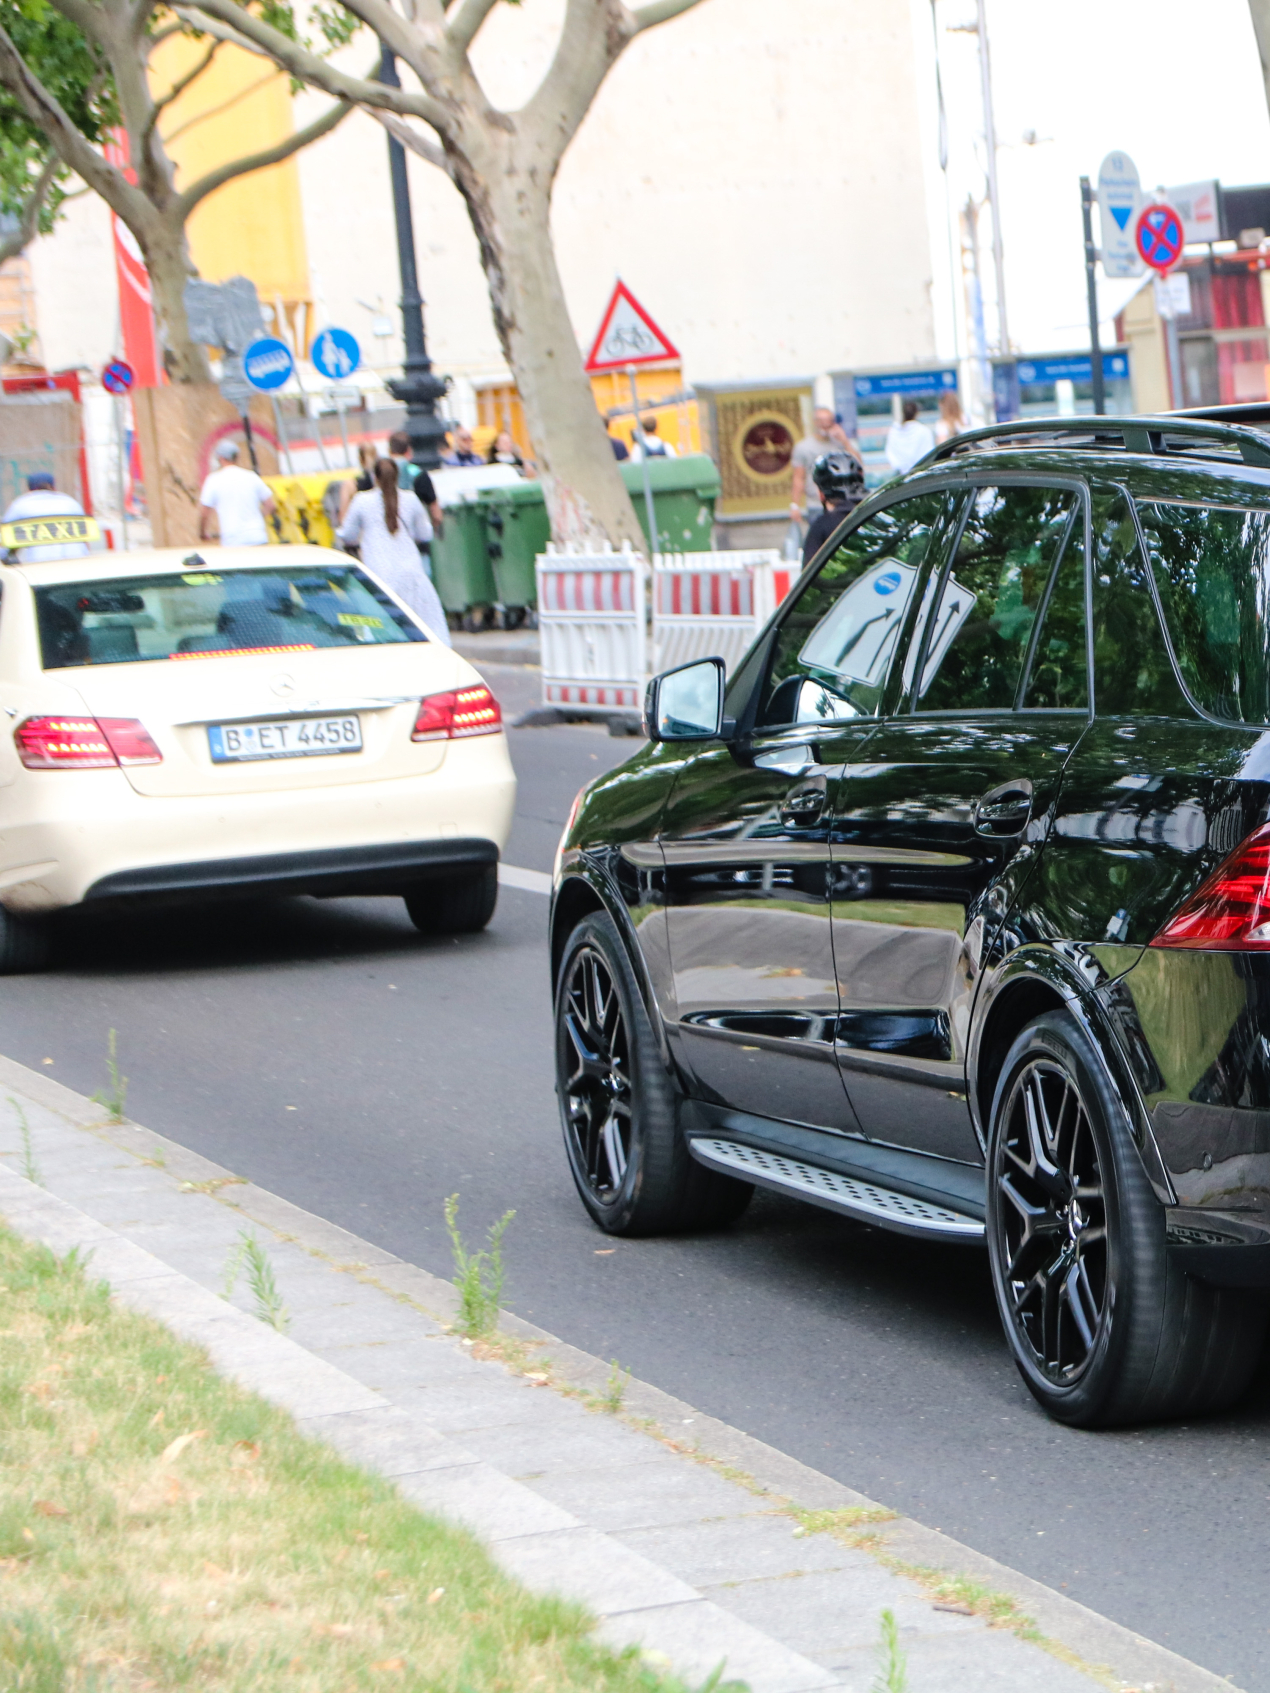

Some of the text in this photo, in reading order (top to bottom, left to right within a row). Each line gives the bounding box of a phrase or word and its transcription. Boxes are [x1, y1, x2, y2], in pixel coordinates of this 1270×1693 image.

[20, 521, 82, 542] TAXI
[225, 720, 356, 752] B ET 4458
